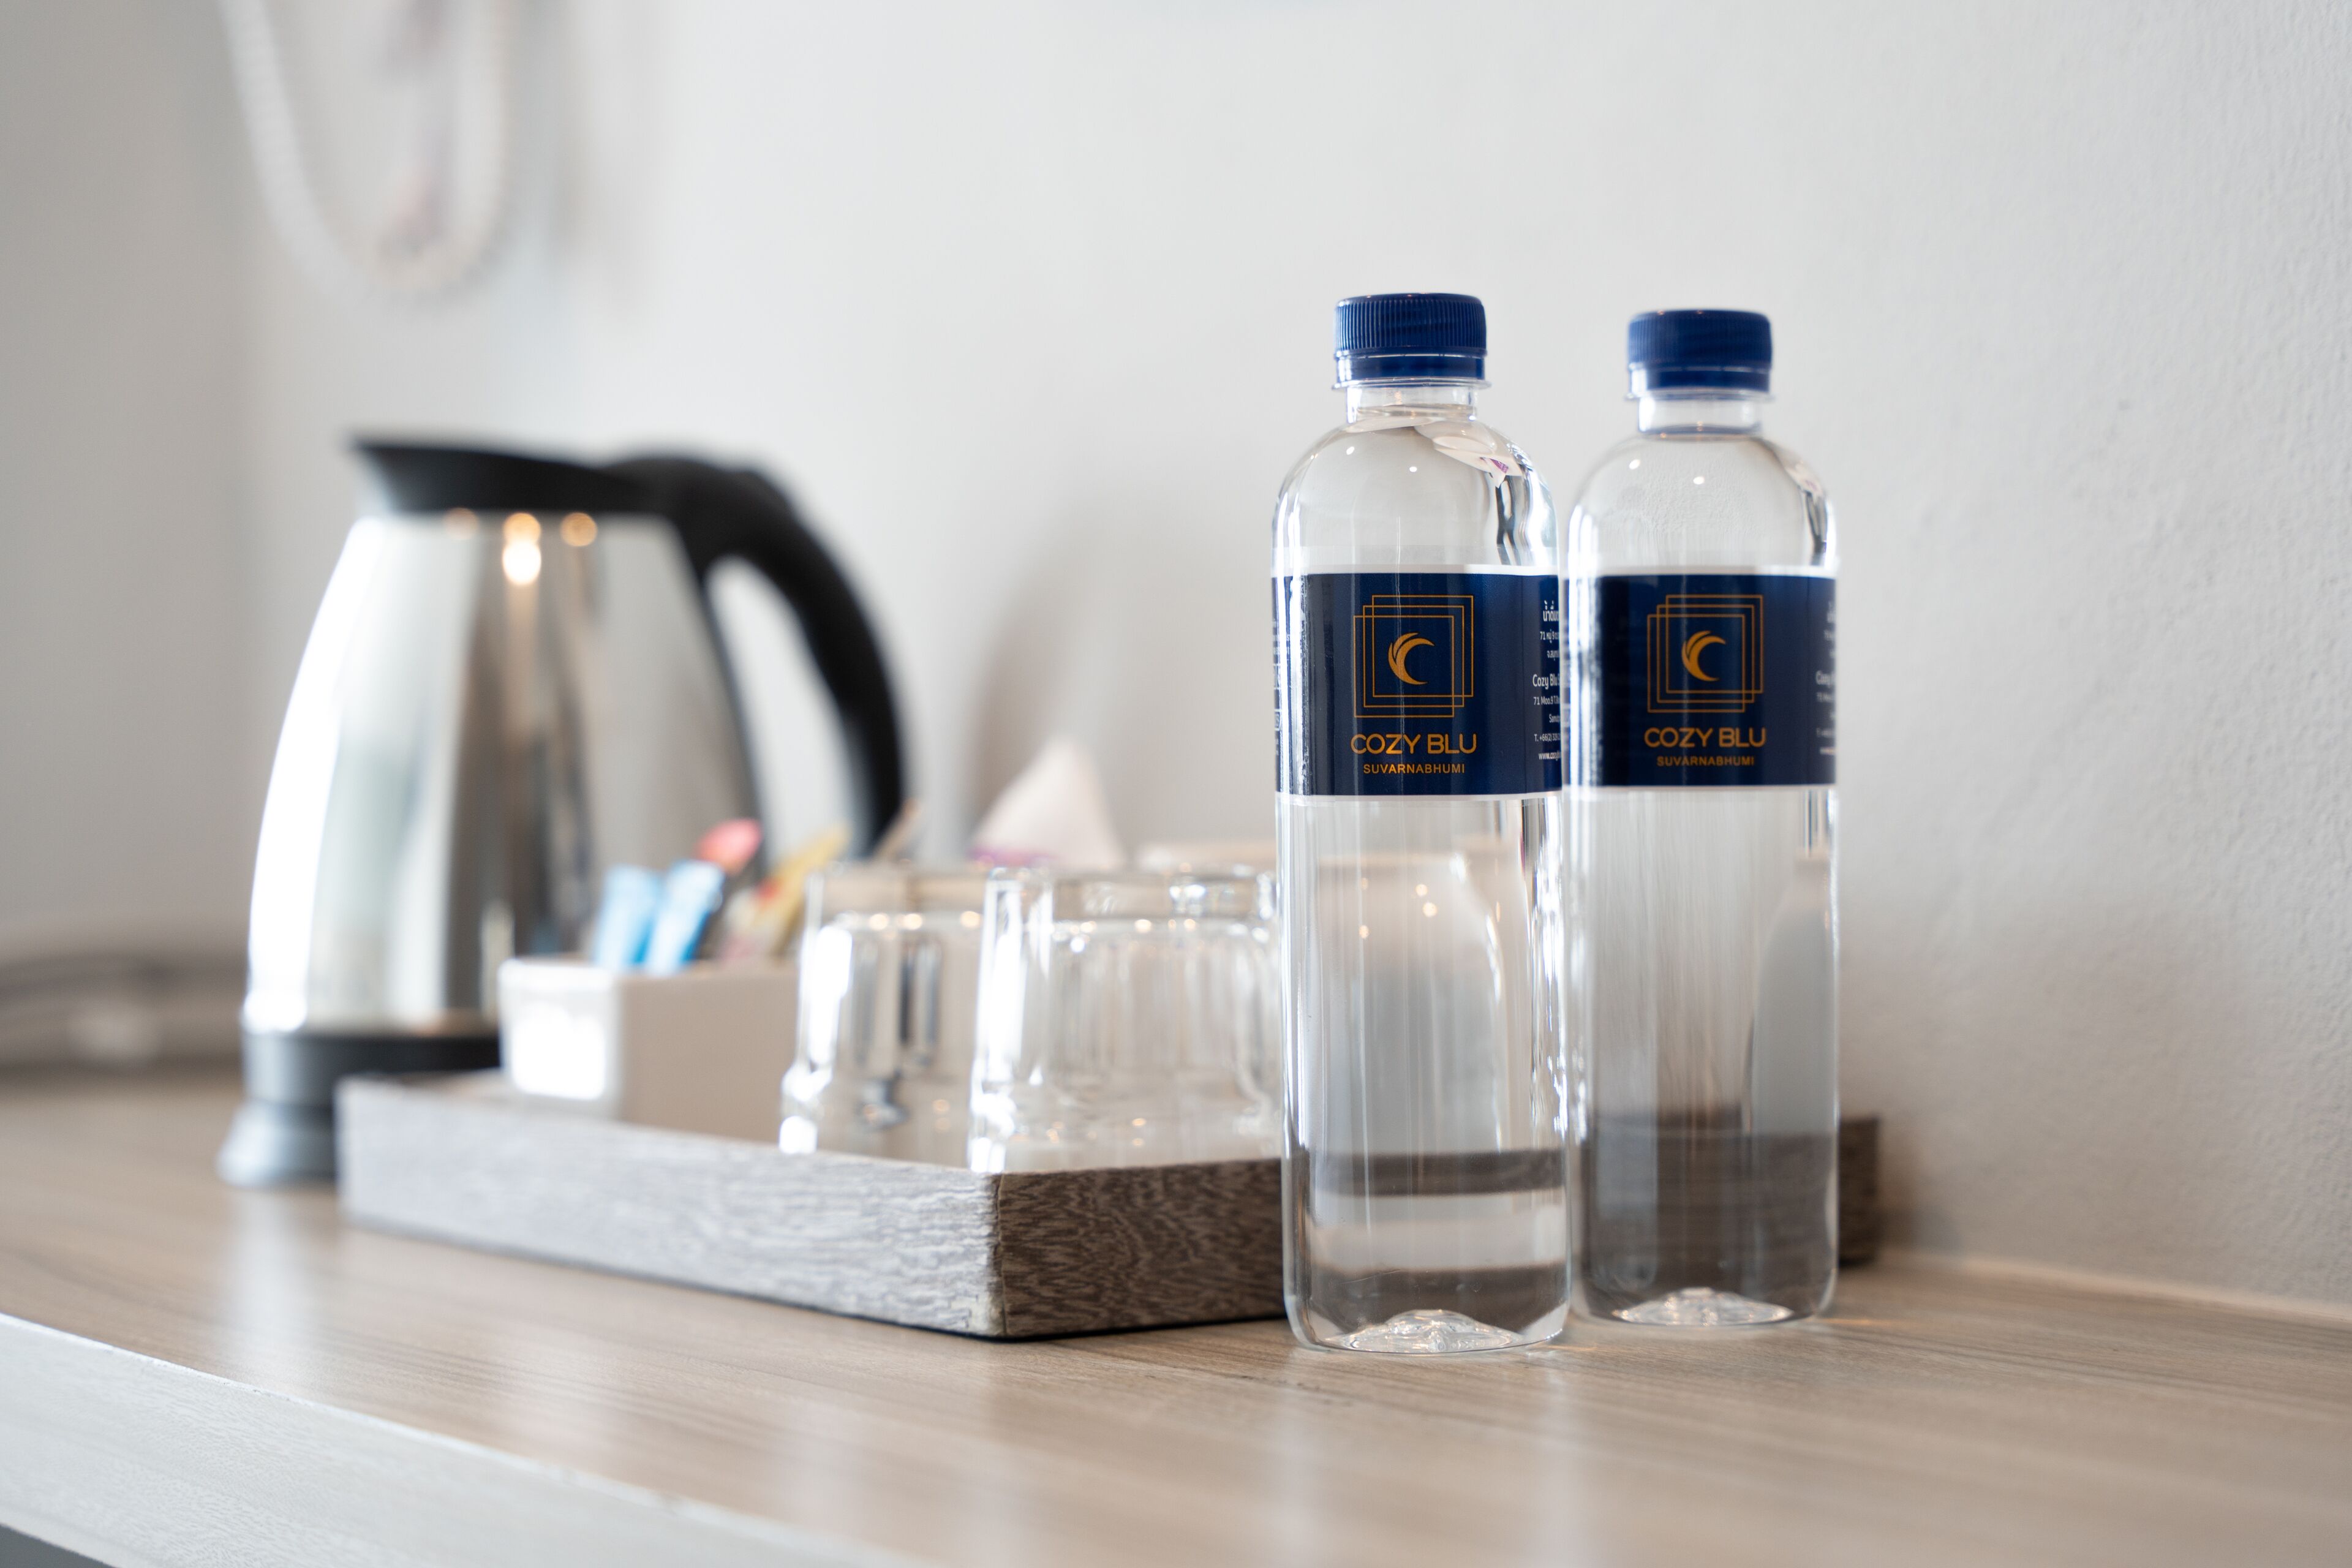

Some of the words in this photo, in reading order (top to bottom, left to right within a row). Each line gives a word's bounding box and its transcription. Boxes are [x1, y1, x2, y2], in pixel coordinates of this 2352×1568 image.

[1540, 631, 1546, 641] 71
[1532, 674, 1548, 690] Cozy
[1534, 696, 1540, 706] 71
[1645, 728, 1713, 747] COZY
[1719, 727, 1766, 747] BLU
[1351, 734, 1420, 755] COZY
[1427, 734, 1477, 754] BLU
[1657, 756, 1754, 766] SUVARNABHUMI
[1363, 764, 1464, 774] SUVARNABHUMI
